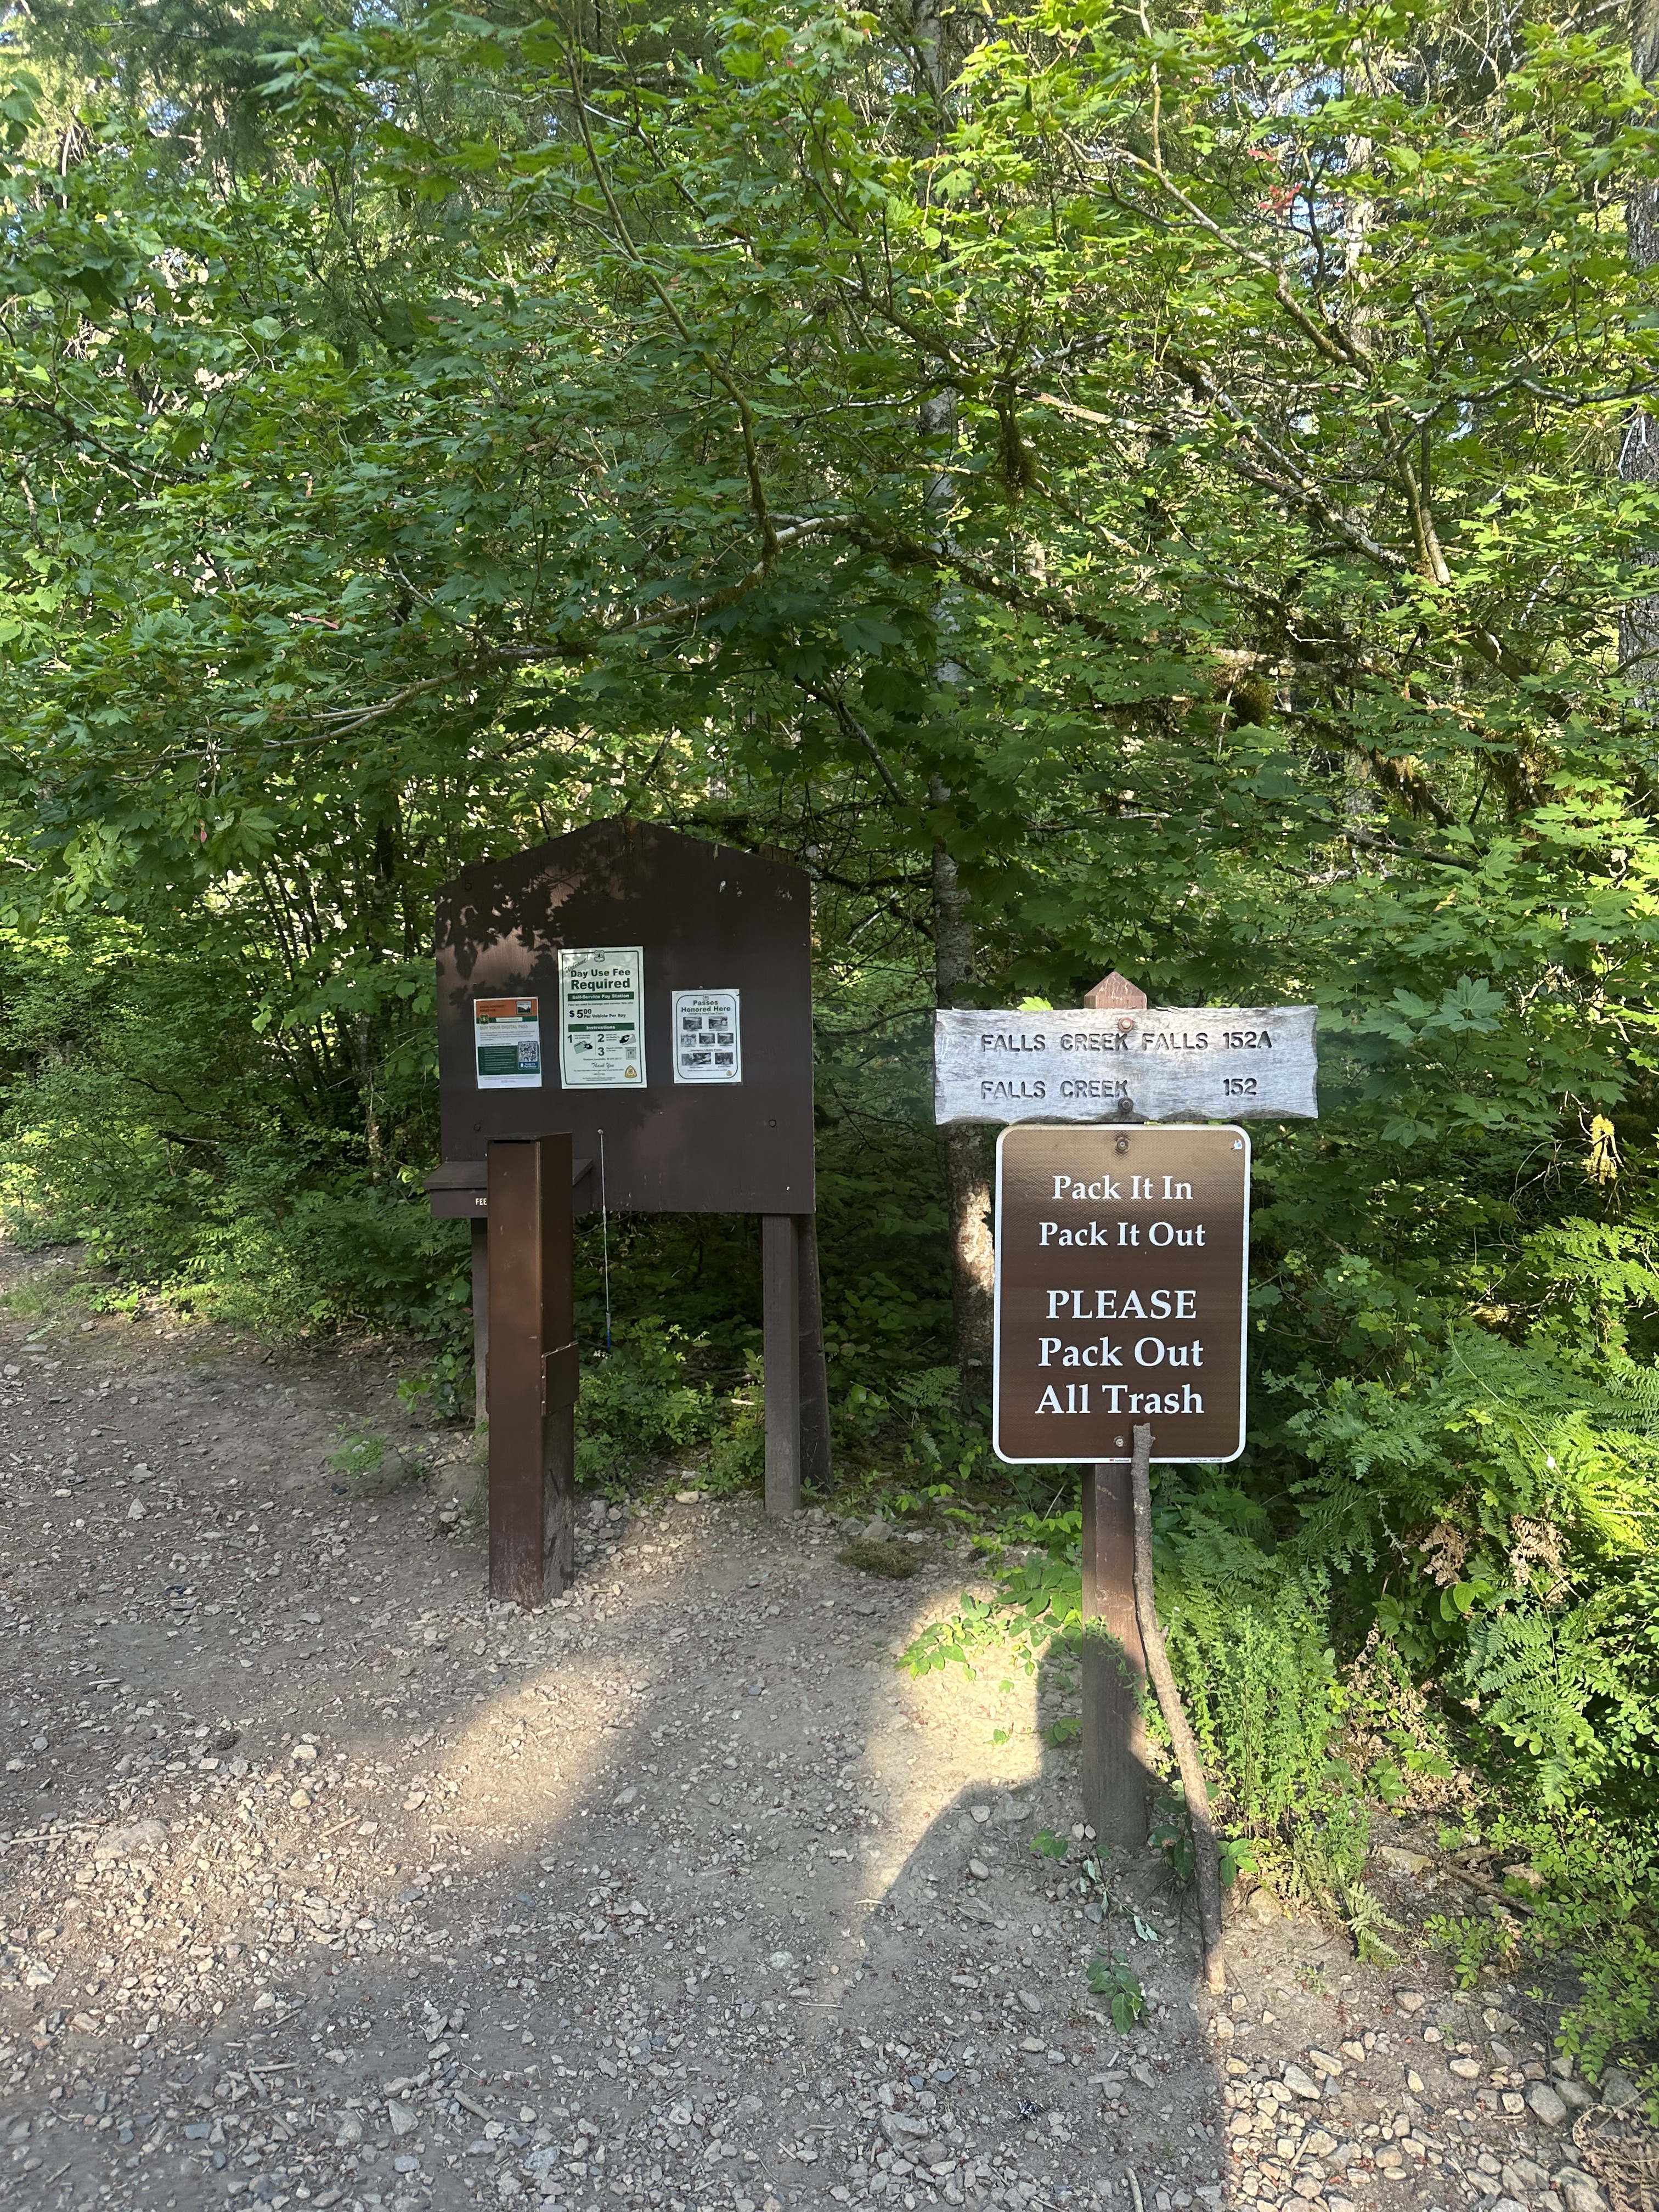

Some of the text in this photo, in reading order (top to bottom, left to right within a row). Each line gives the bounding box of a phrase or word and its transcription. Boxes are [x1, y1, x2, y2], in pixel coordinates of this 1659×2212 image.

[571, 970, 588, 979] Day
[571, 978, 630, 991] Required
[567, 1034, 573, 1043] 1
[597, 1034, 605, 1042] 2
[980, 1031, 1272, 1053] FALLS CREEK FALLS 152A
[597, 1047, 605, 1056] 3
[980, 1078, 1257, 1098] FALLS CREEK 152
[1052, 1175, 1193, 1200] Pack It In
[1039, 1221, 1206, 1246] Pack It Out
[1046, 1289, 1197, 1319] PLEASE
[1038, 1336, 1204, 1367] Pack Out
[1035, 1384, 1205, 1414] All Trash
